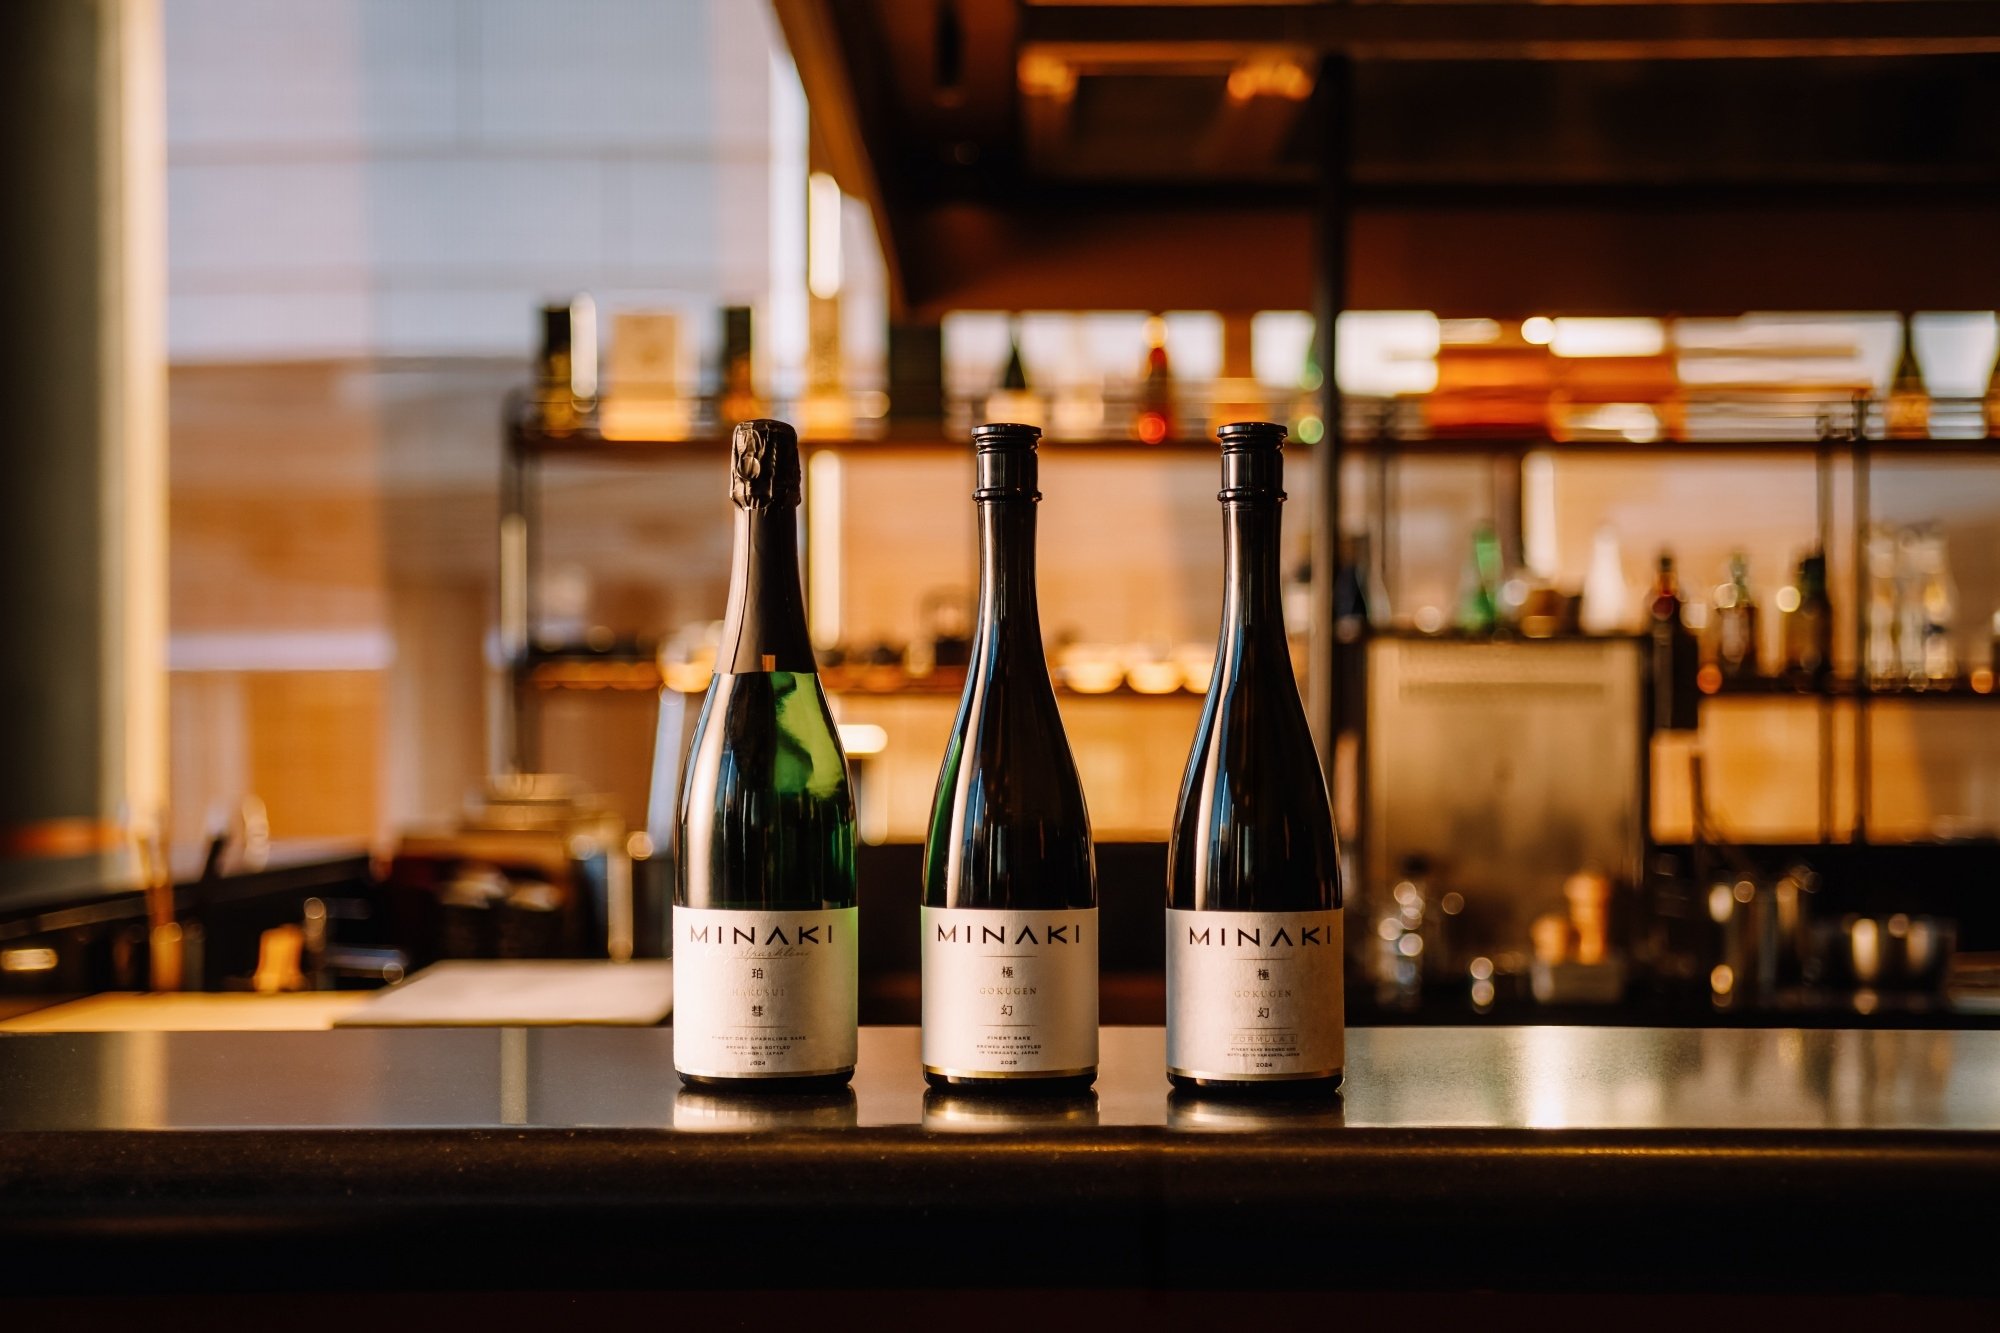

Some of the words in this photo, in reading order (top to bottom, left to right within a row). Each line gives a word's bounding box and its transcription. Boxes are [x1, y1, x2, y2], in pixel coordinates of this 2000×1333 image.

[690, 925, 832, 945] MINAKI
[937, 923, 1080, 945] MINAKI
[1189, 926, 1331, 947] MINAKI
[751, 968, 764, 980] 珀
[1001, 966, 1014, 979] 極
[1257, 968, 1270, 981] 極
[979, 987, 1037, 995] GOKUGEN
[1235, 990, 1292, 998] GOKUGEN
[1001, 1004, 1013, 1017] 幻
[1257, 1007, 1270, 1019] 幻
